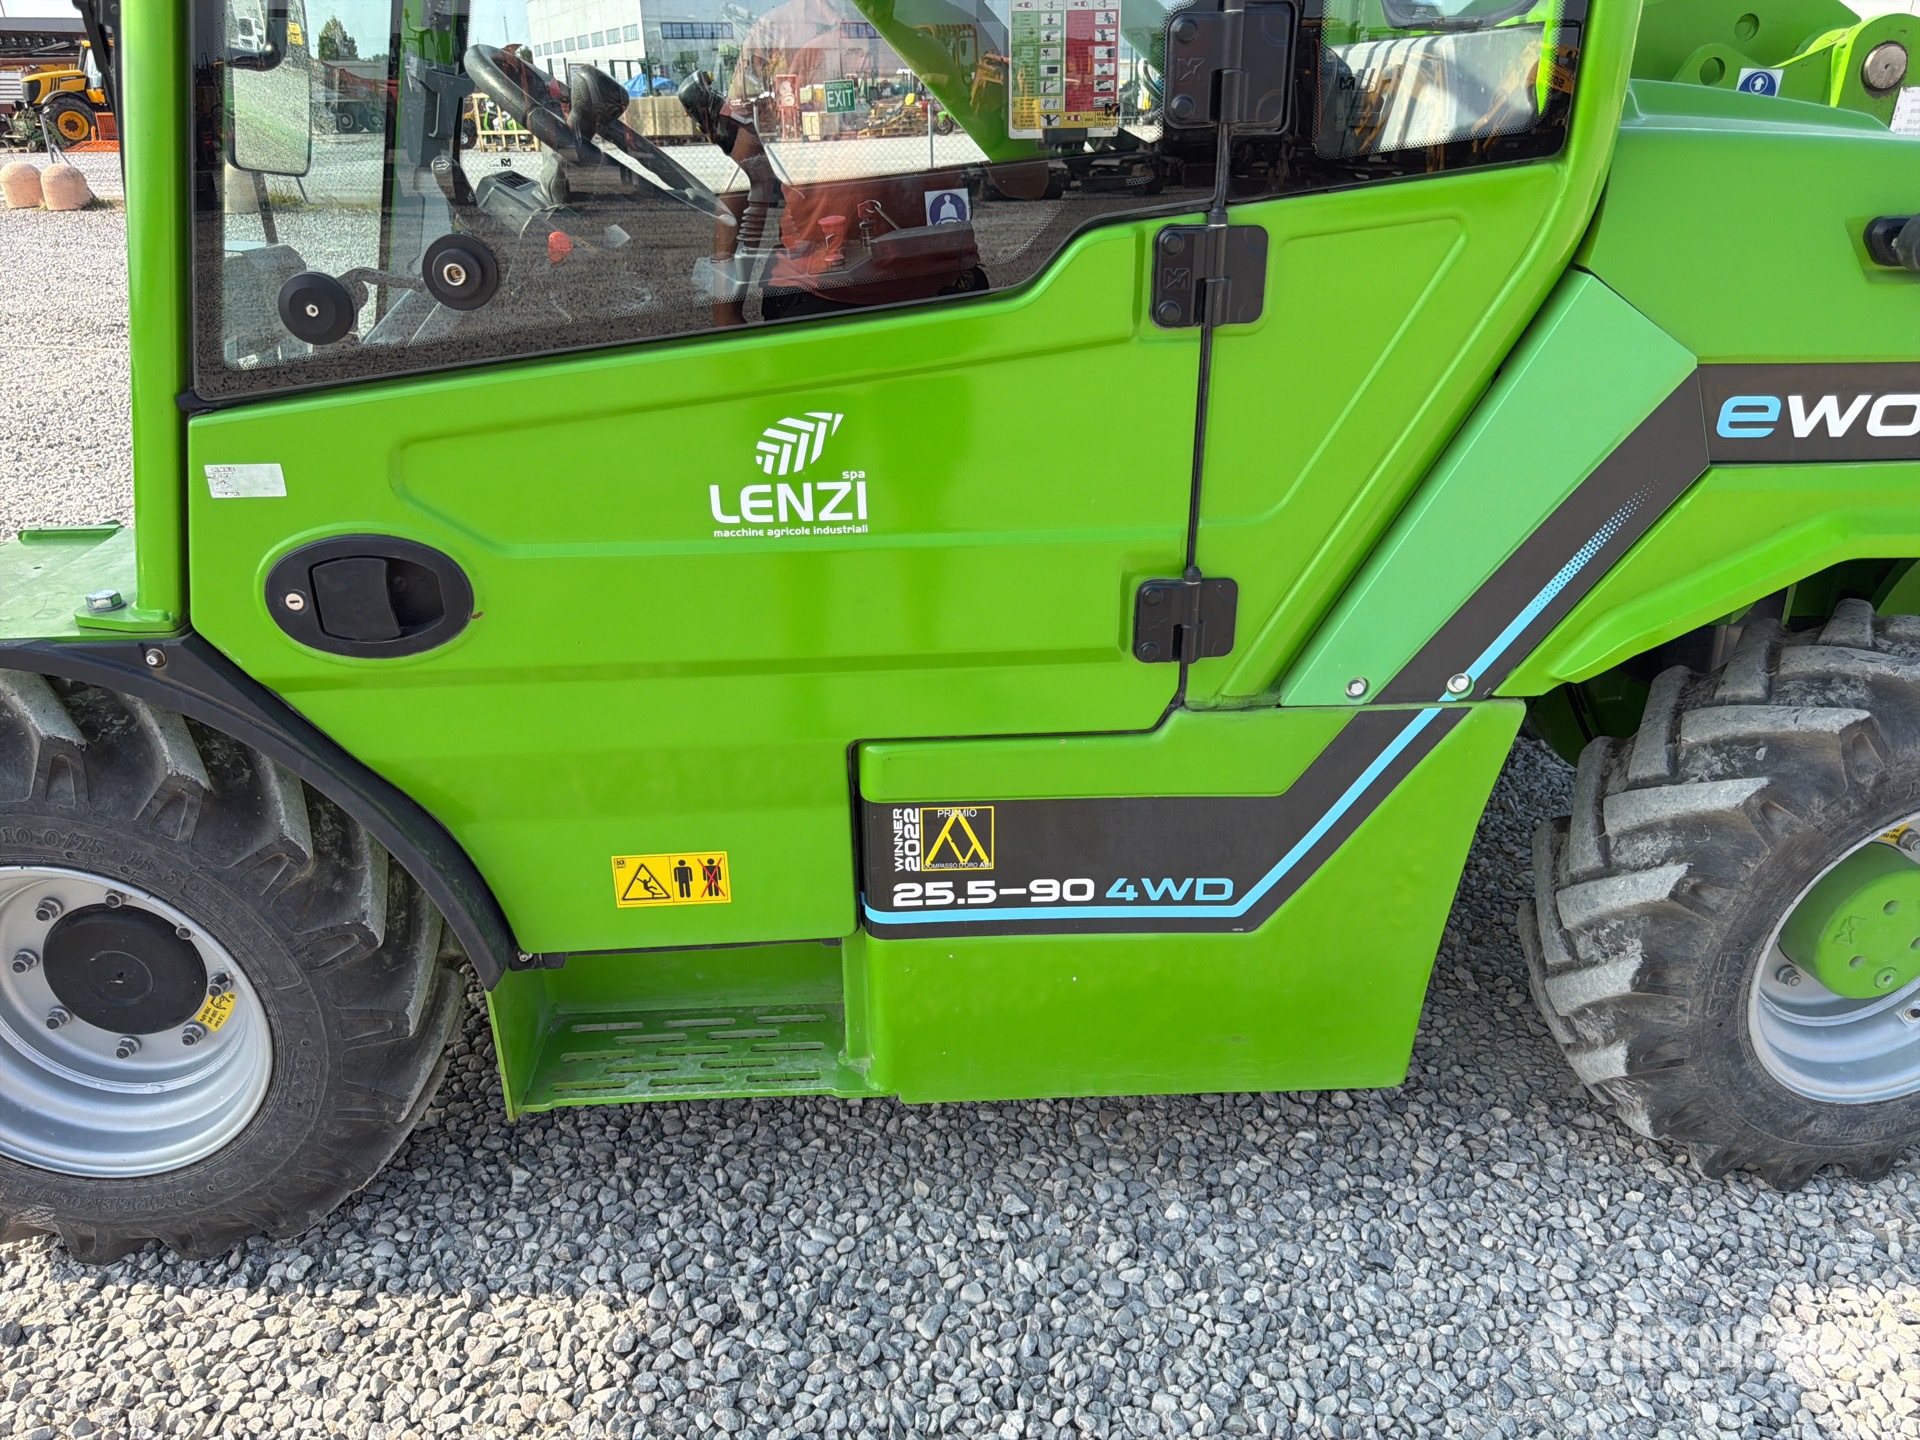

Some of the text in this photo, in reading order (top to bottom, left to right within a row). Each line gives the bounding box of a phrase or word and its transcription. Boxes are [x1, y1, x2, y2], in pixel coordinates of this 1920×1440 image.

[826, 82, 852, 90] EMERGENCY
[826, 90, 852, 107] EXIT
[842, 471, 866, 481] spa
[709, 481, 868, 524] LENZI
[713, 524, 869, 538] macchine agricole industriali
[937, 808, 978, 818] PREMIO
[3, 827, 110, 854] 10.0/75
[893, 808, 904, 873] WINNER
[904, 807, 921, 872] 2022
[924, 862, 958, 870] COMPASSO
[1106, 877, 1234, 901] 4WD
